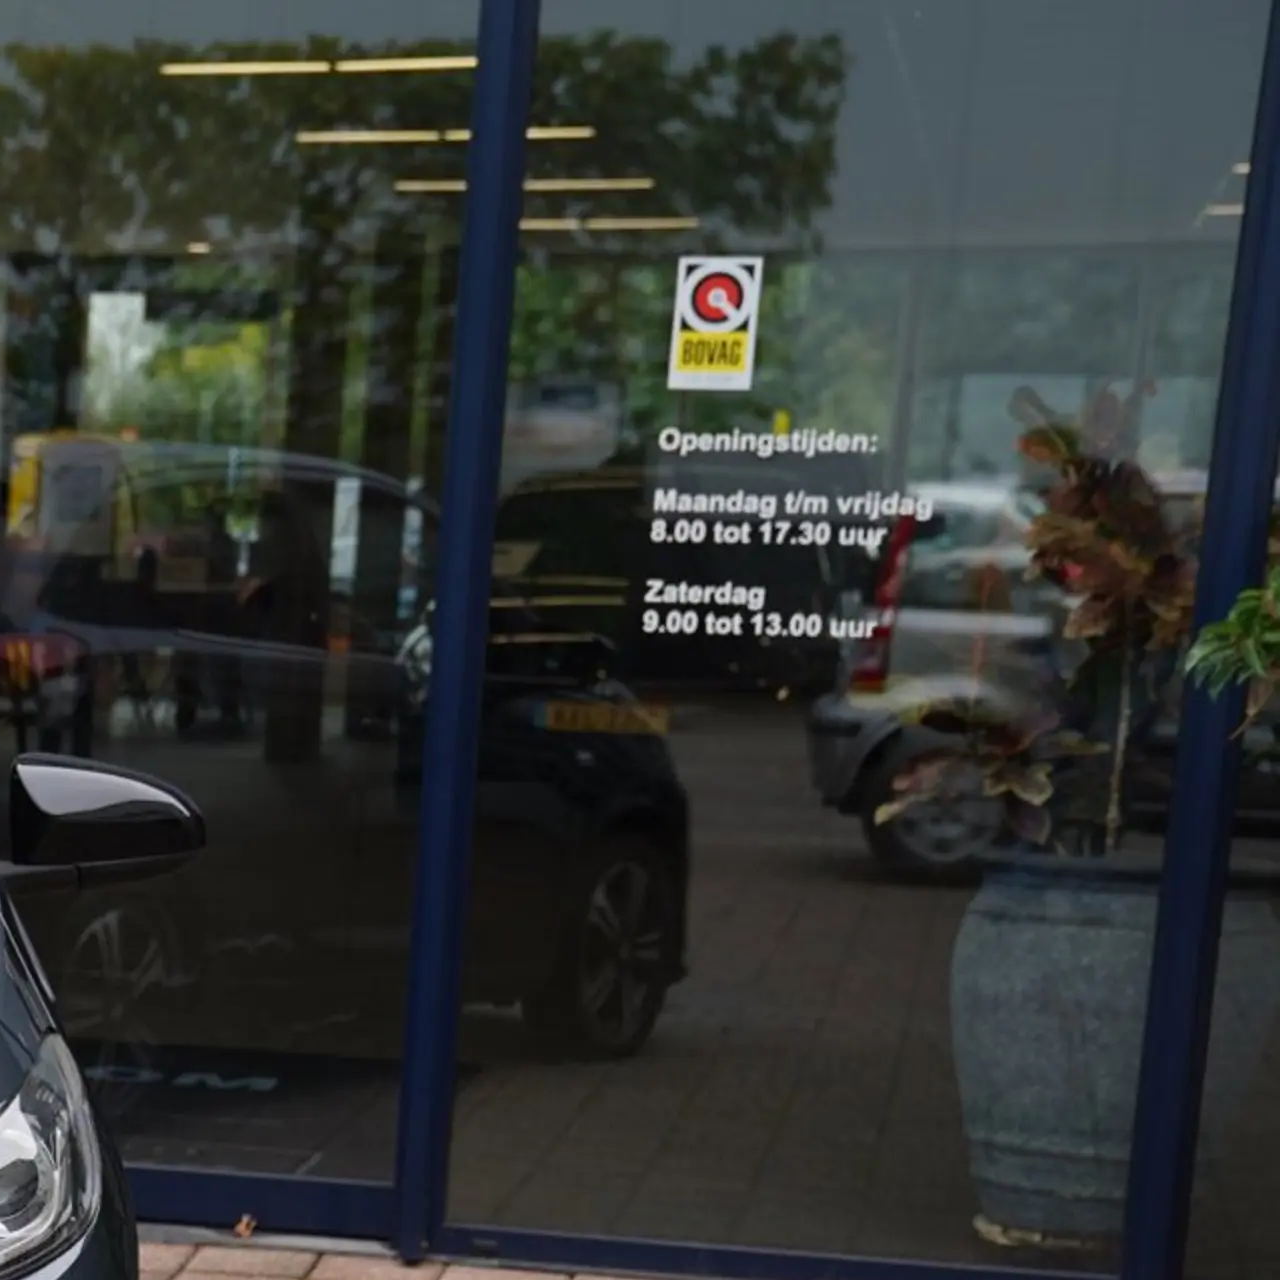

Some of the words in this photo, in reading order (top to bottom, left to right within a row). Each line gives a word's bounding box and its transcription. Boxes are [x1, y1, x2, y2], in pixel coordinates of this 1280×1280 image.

[682, 339, 742, 366] BOVAG
[658, 427, 879, 457] Openingstijden:
[653, 489, 776, 518] Maandag
[784, 491, 828, 515] t/m
[836, 493, 933, 521] vrijdag
[650, 520, 706, 544] 8.00
[713, 522, 751, 545] tot
[758, 523, 830, 546] 17.30
[838, 527, 888, 548] uur
[644, 579, 766, 609] Zaterdag
[642, 610, 698, 634] 9.00
[705, 612, 743, 636] tot
[750, 613, 822, 638] 13.00
[829, 617, 879, 639] uur
